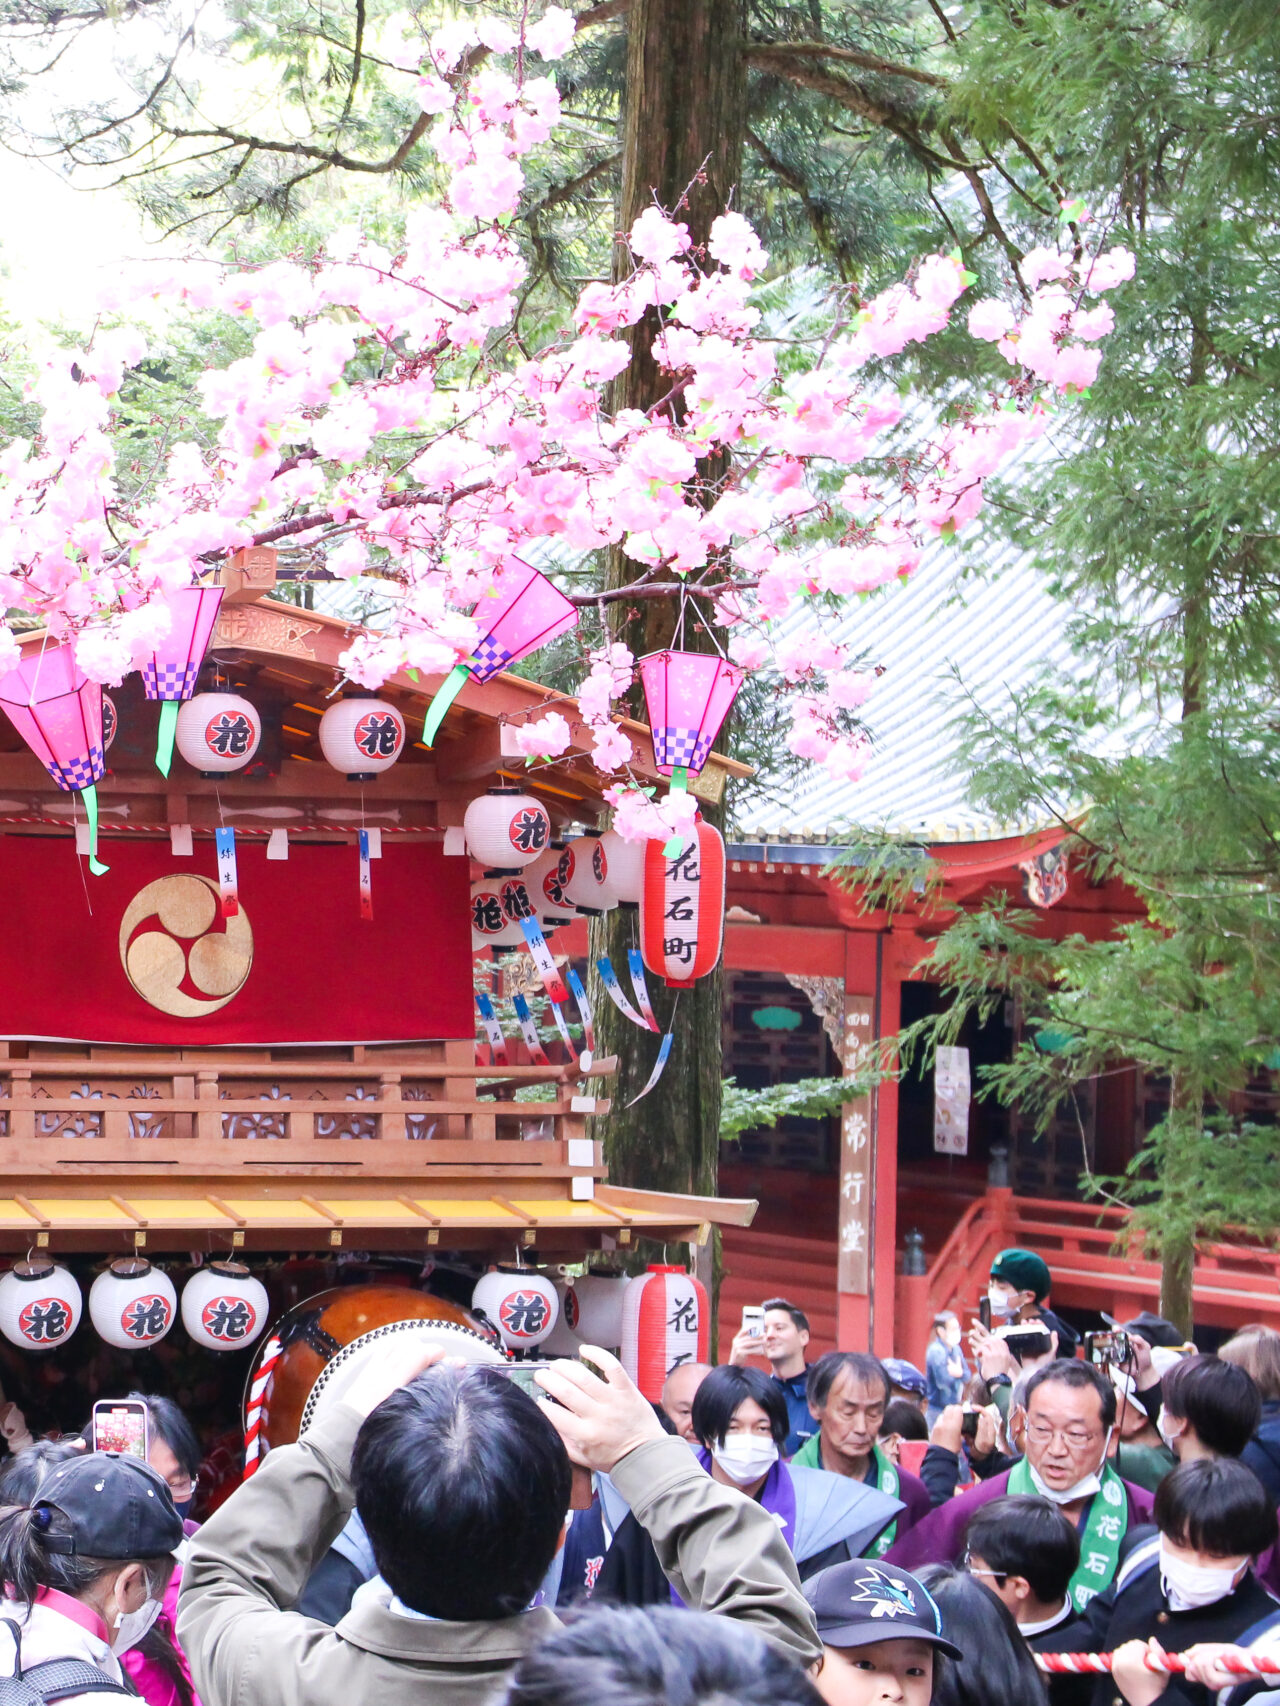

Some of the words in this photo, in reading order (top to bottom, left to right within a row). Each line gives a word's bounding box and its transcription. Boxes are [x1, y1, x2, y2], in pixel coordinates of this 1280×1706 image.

[211, 715, 251, 754] 花
[360, 715, 398, 755] 花
[514, 811, 548, 849] 花
[472, 896, 503, 930] 花
[663, 842, 702, 964] 花石町
[842, 1112, 868, 1252] 常行堂
[23, 1301, 67, 1340] 花
[127, 1298, 167, 1338] 花
[206, 1299, 251, 1338] 花
[504, 1295, 547, 1334] 花
